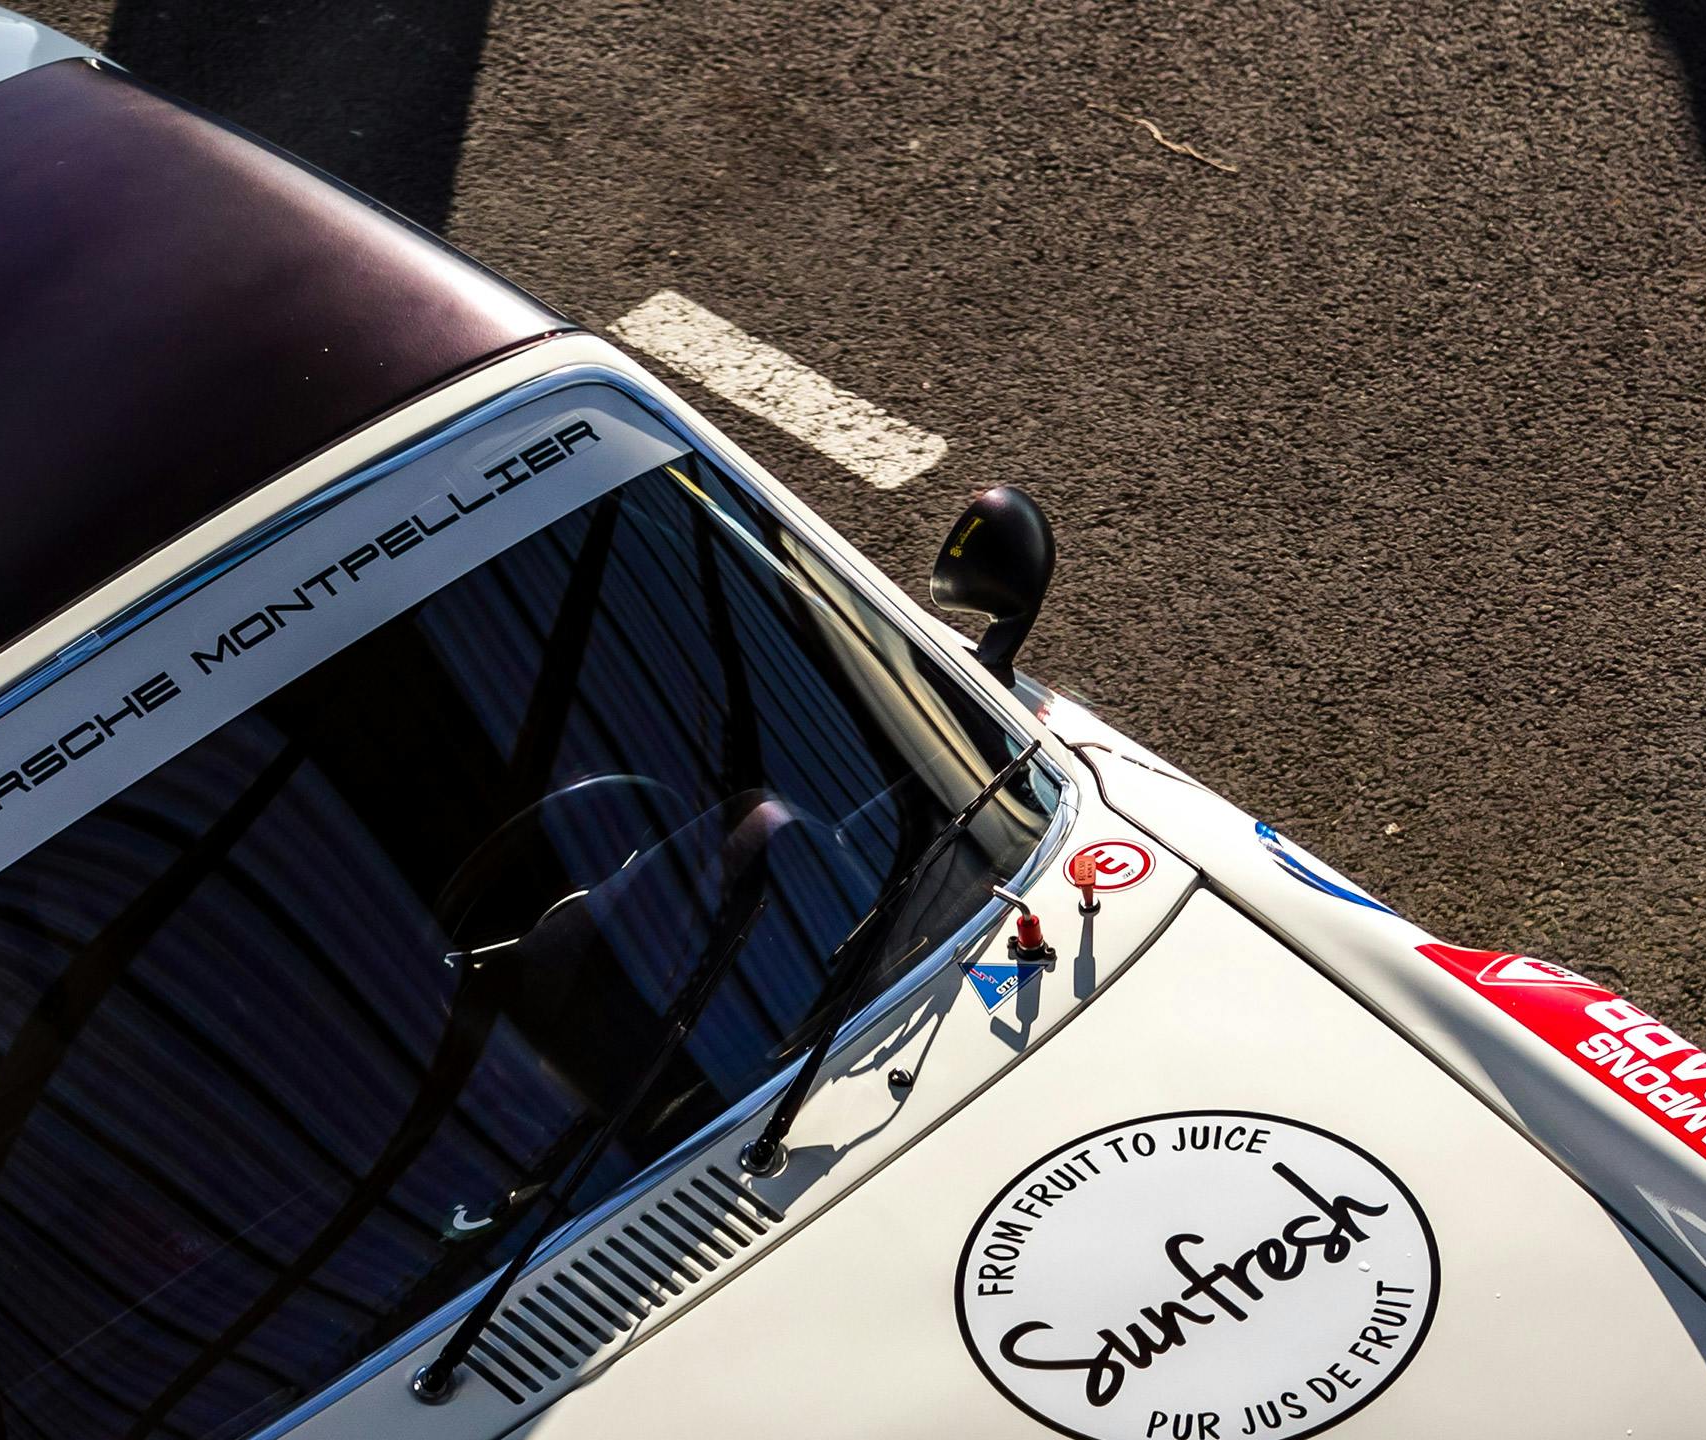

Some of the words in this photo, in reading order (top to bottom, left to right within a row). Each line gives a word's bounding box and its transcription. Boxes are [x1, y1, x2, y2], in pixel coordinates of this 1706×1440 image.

[190, 420, 601, 675] MONTPELLIER
[977, 1220, 1034, 1296] FROM
[1013, 1150, 1101, 1219] FRUIT
[1104, 1133, 1156, 1164] TO
[1172, 1125, 1271, 1154] JUICE
[999, 1162, 1389, 1407] Sunfresh
[1147, 1411, 1220, 1440] PUR
[1241, 1392, 1307, 1437] JUS
[1307, 1362, 1362, 1403] DE
[1349, 1279, 1415, 1365] FRUIT
